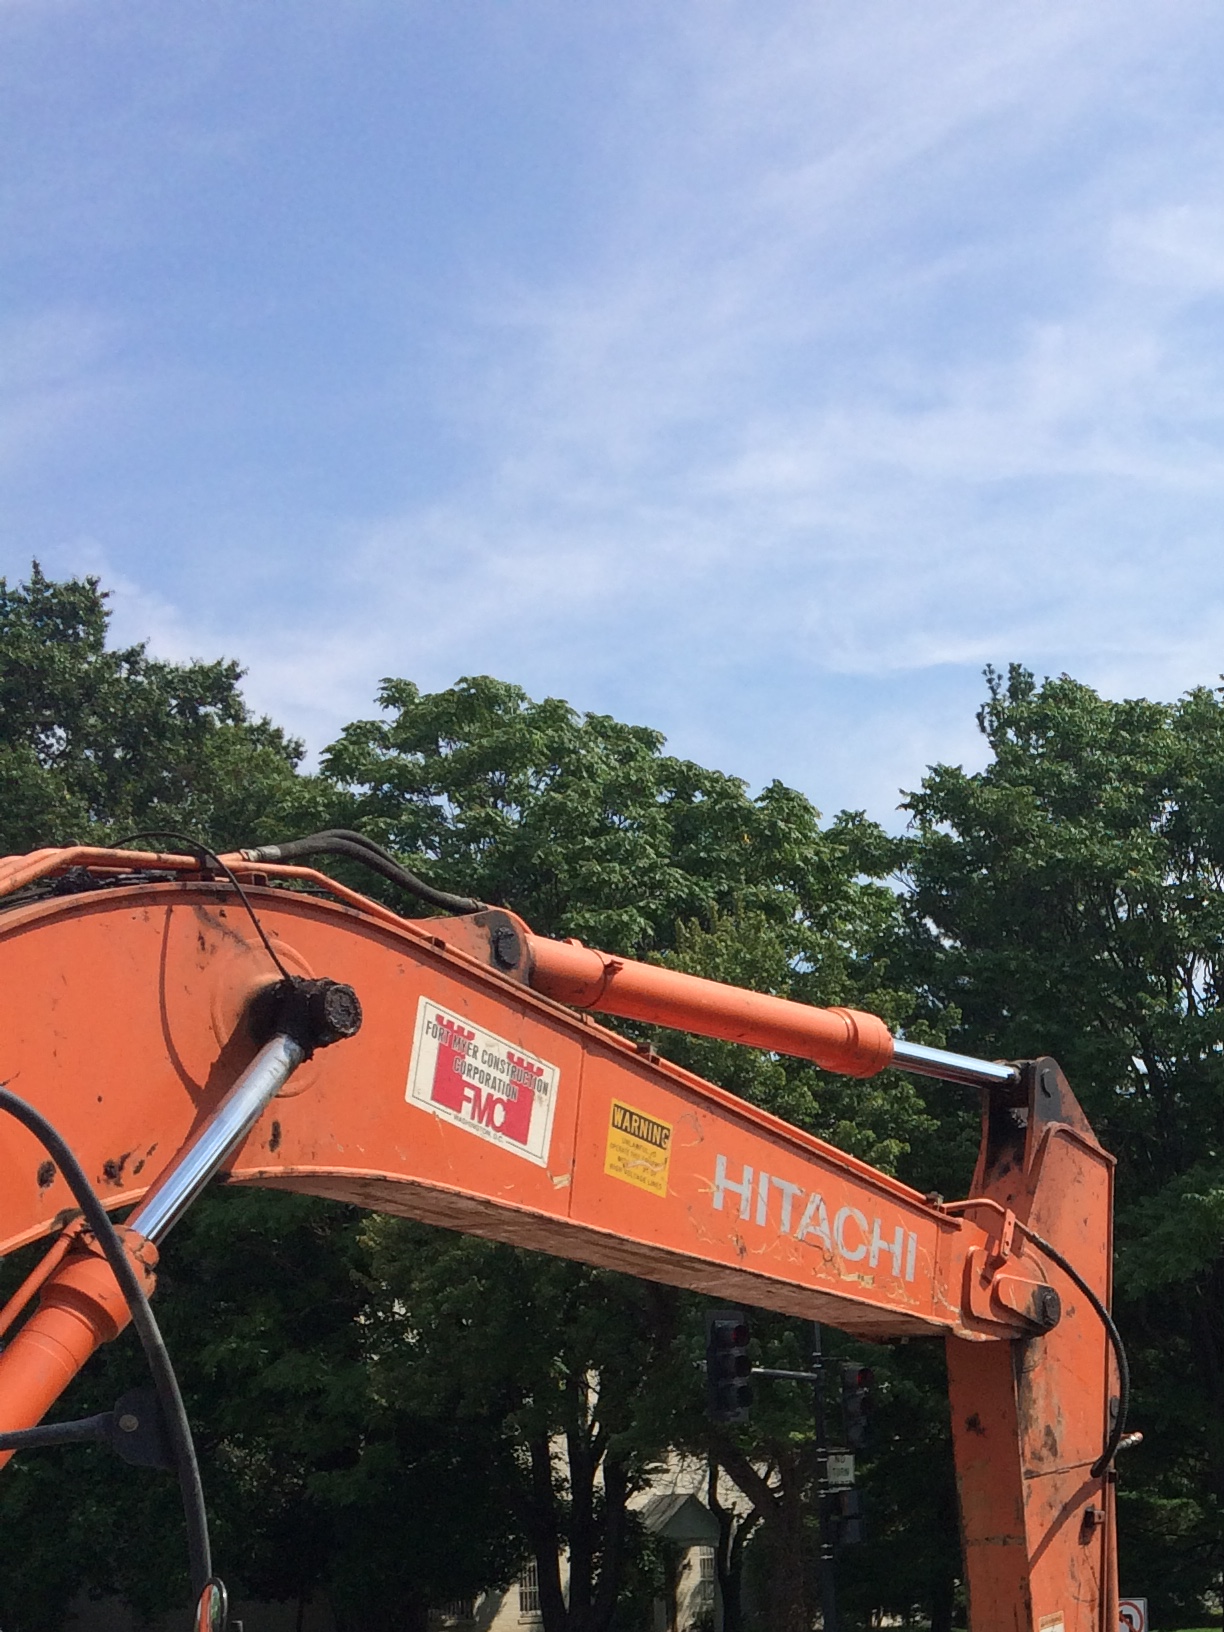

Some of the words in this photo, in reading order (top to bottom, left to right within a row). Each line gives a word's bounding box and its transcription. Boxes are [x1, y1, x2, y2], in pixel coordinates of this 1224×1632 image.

[425, 1020, 451, 1047] FORT
[452, 1034, 481, 1061] MYER
[481, 1049, 549, 1096] CONSTRUCTION
[453, 1056, 518, 1099] CORPORATION
[614, 1106, 669, 1149] WARNING
[713, 1153, 918, 1282] HITACHI
